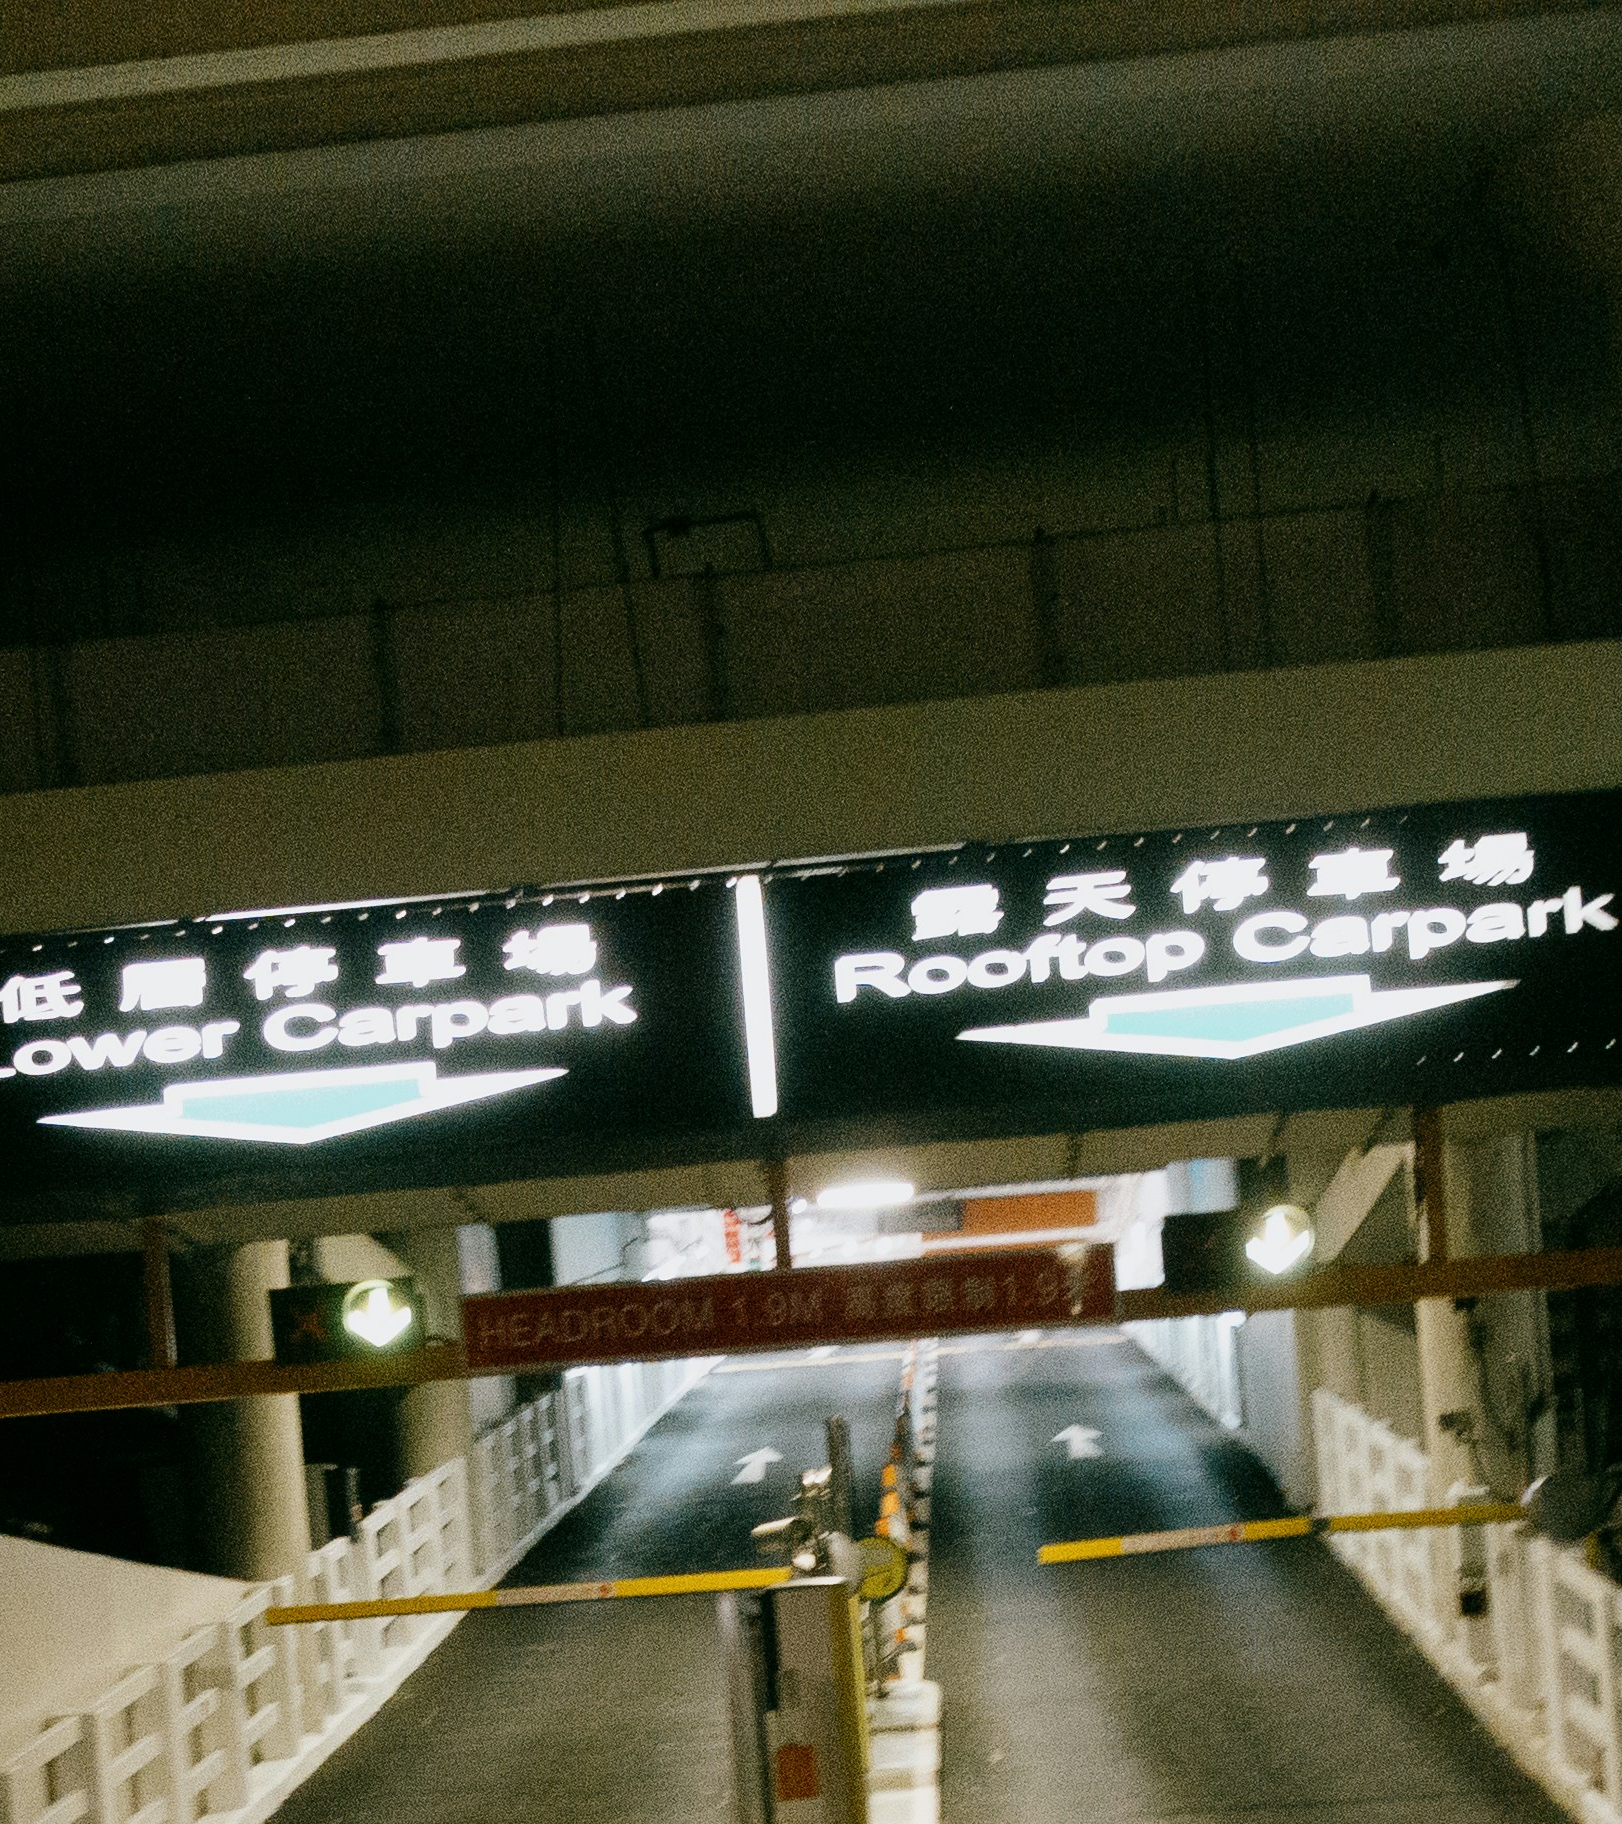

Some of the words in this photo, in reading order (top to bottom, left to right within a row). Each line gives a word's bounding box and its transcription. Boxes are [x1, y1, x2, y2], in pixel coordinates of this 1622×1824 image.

[834, 930, 1205, 1003] Rooftop
[1230, 886, 1617, 966] Carpark
[263, 979, 638, 1054] Carpark
[479, 1299, 716, 1351] HEADROOM
[730, 1290, 824, 1331] 1.9M
